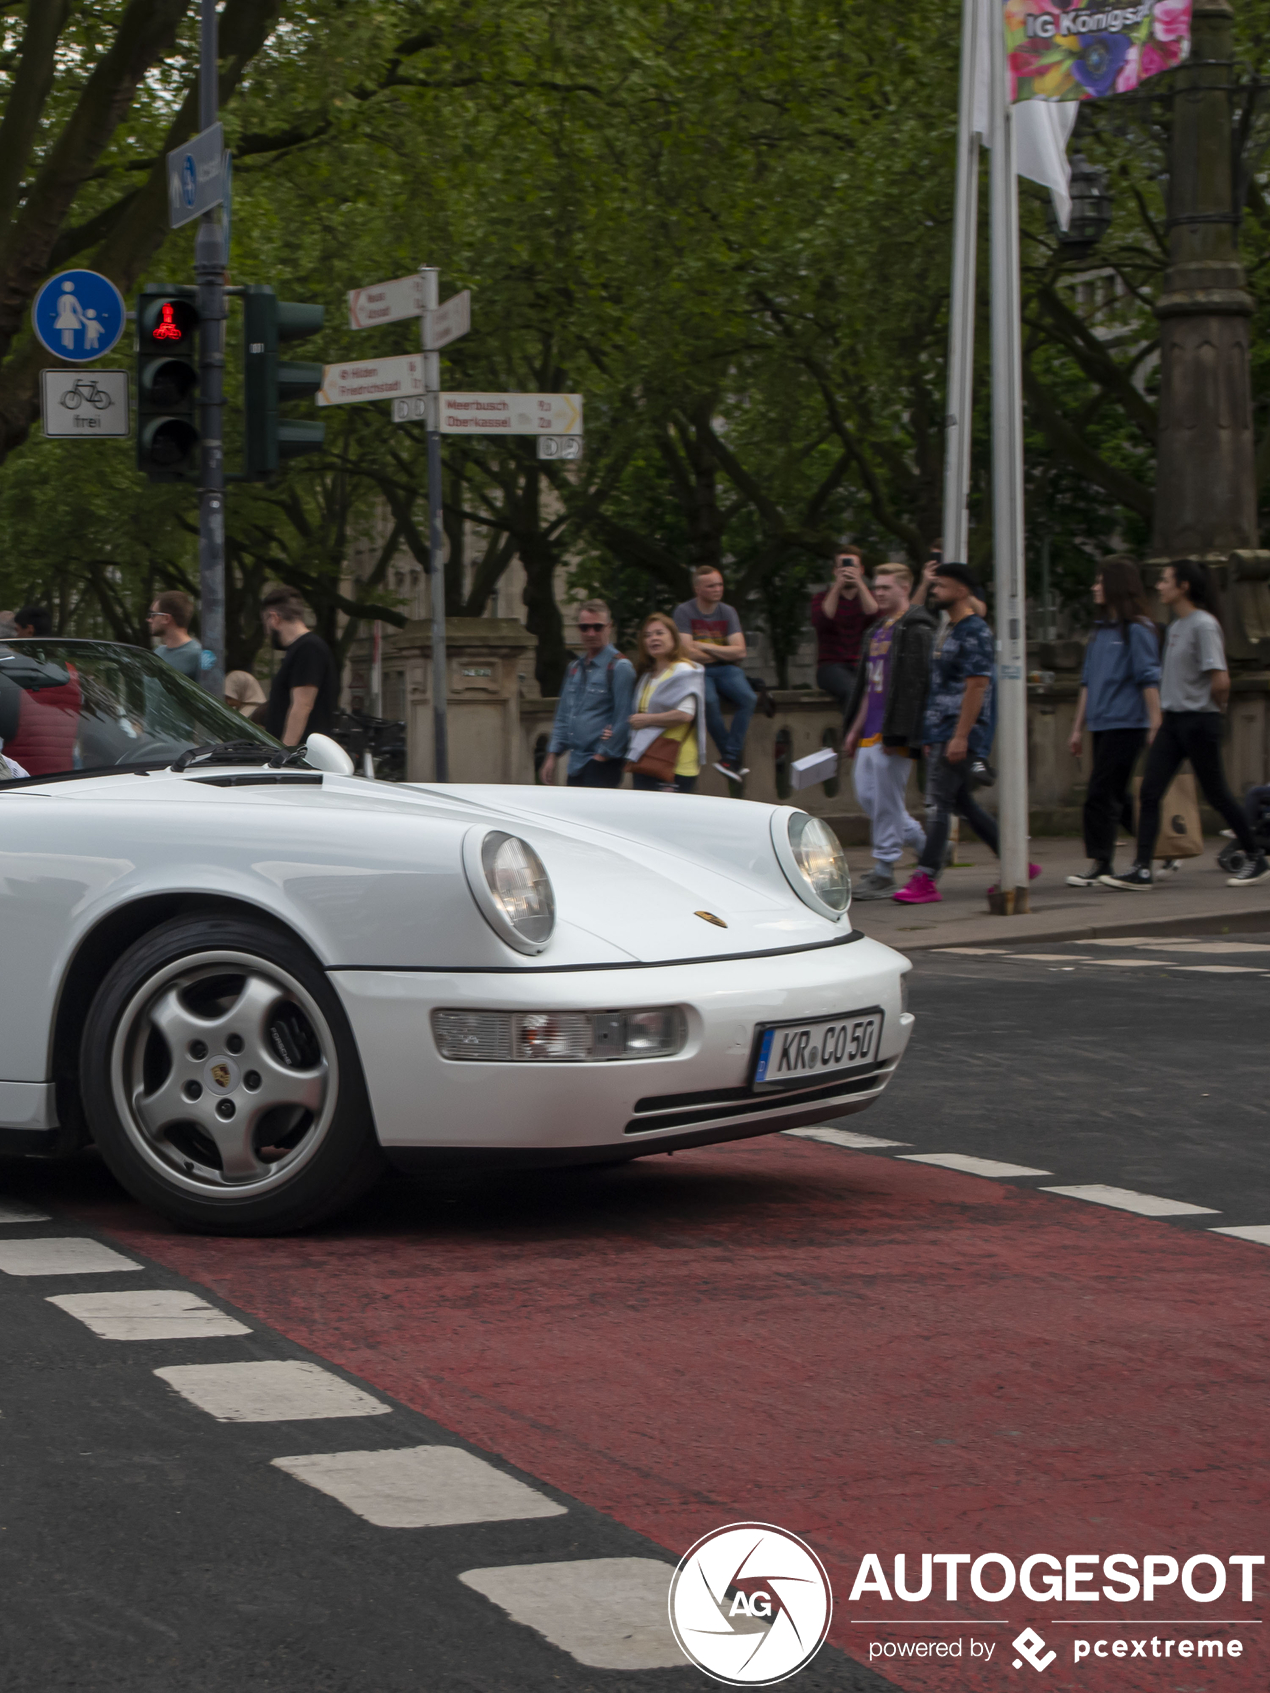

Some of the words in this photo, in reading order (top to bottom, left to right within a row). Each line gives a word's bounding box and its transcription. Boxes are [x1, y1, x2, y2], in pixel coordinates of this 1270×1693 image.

[1026, 13, 1056, 38] IG
[445, 399, 509, 411] Meerbusch
[73, 414, 101, 428] frei
[445, 415, 512, 428] Oberkassel
[270, 1027, 292, 1065] PORSCHE
[777, 1029, 811, 1072] KR
[821, 1024, 848, 1066] CO
[848, 1019, 875, 1061] 50
